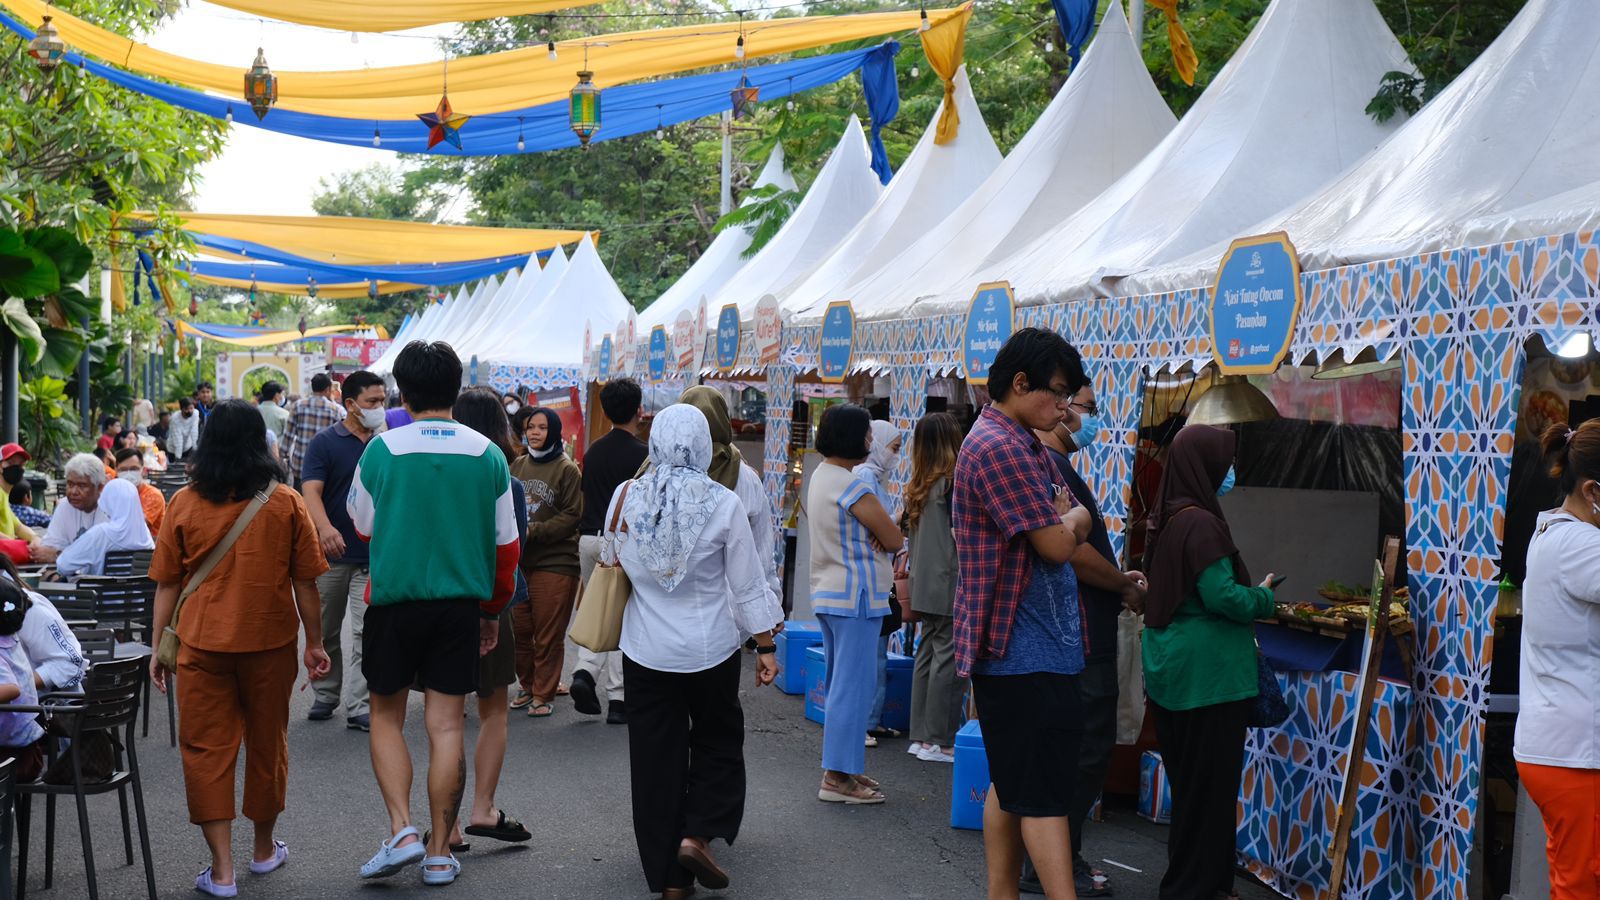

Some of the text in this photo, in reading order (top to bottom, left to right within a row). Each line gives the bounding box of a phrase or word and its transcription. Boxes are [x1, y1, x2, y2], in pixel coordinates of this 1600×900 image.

[1224, 289, 1239, 306] Nasi
[1259, 286, 1284, 302] Oncom
[1235, 312, 1267, 329] Pasundan
[50, 622, 62, 642] KARL
